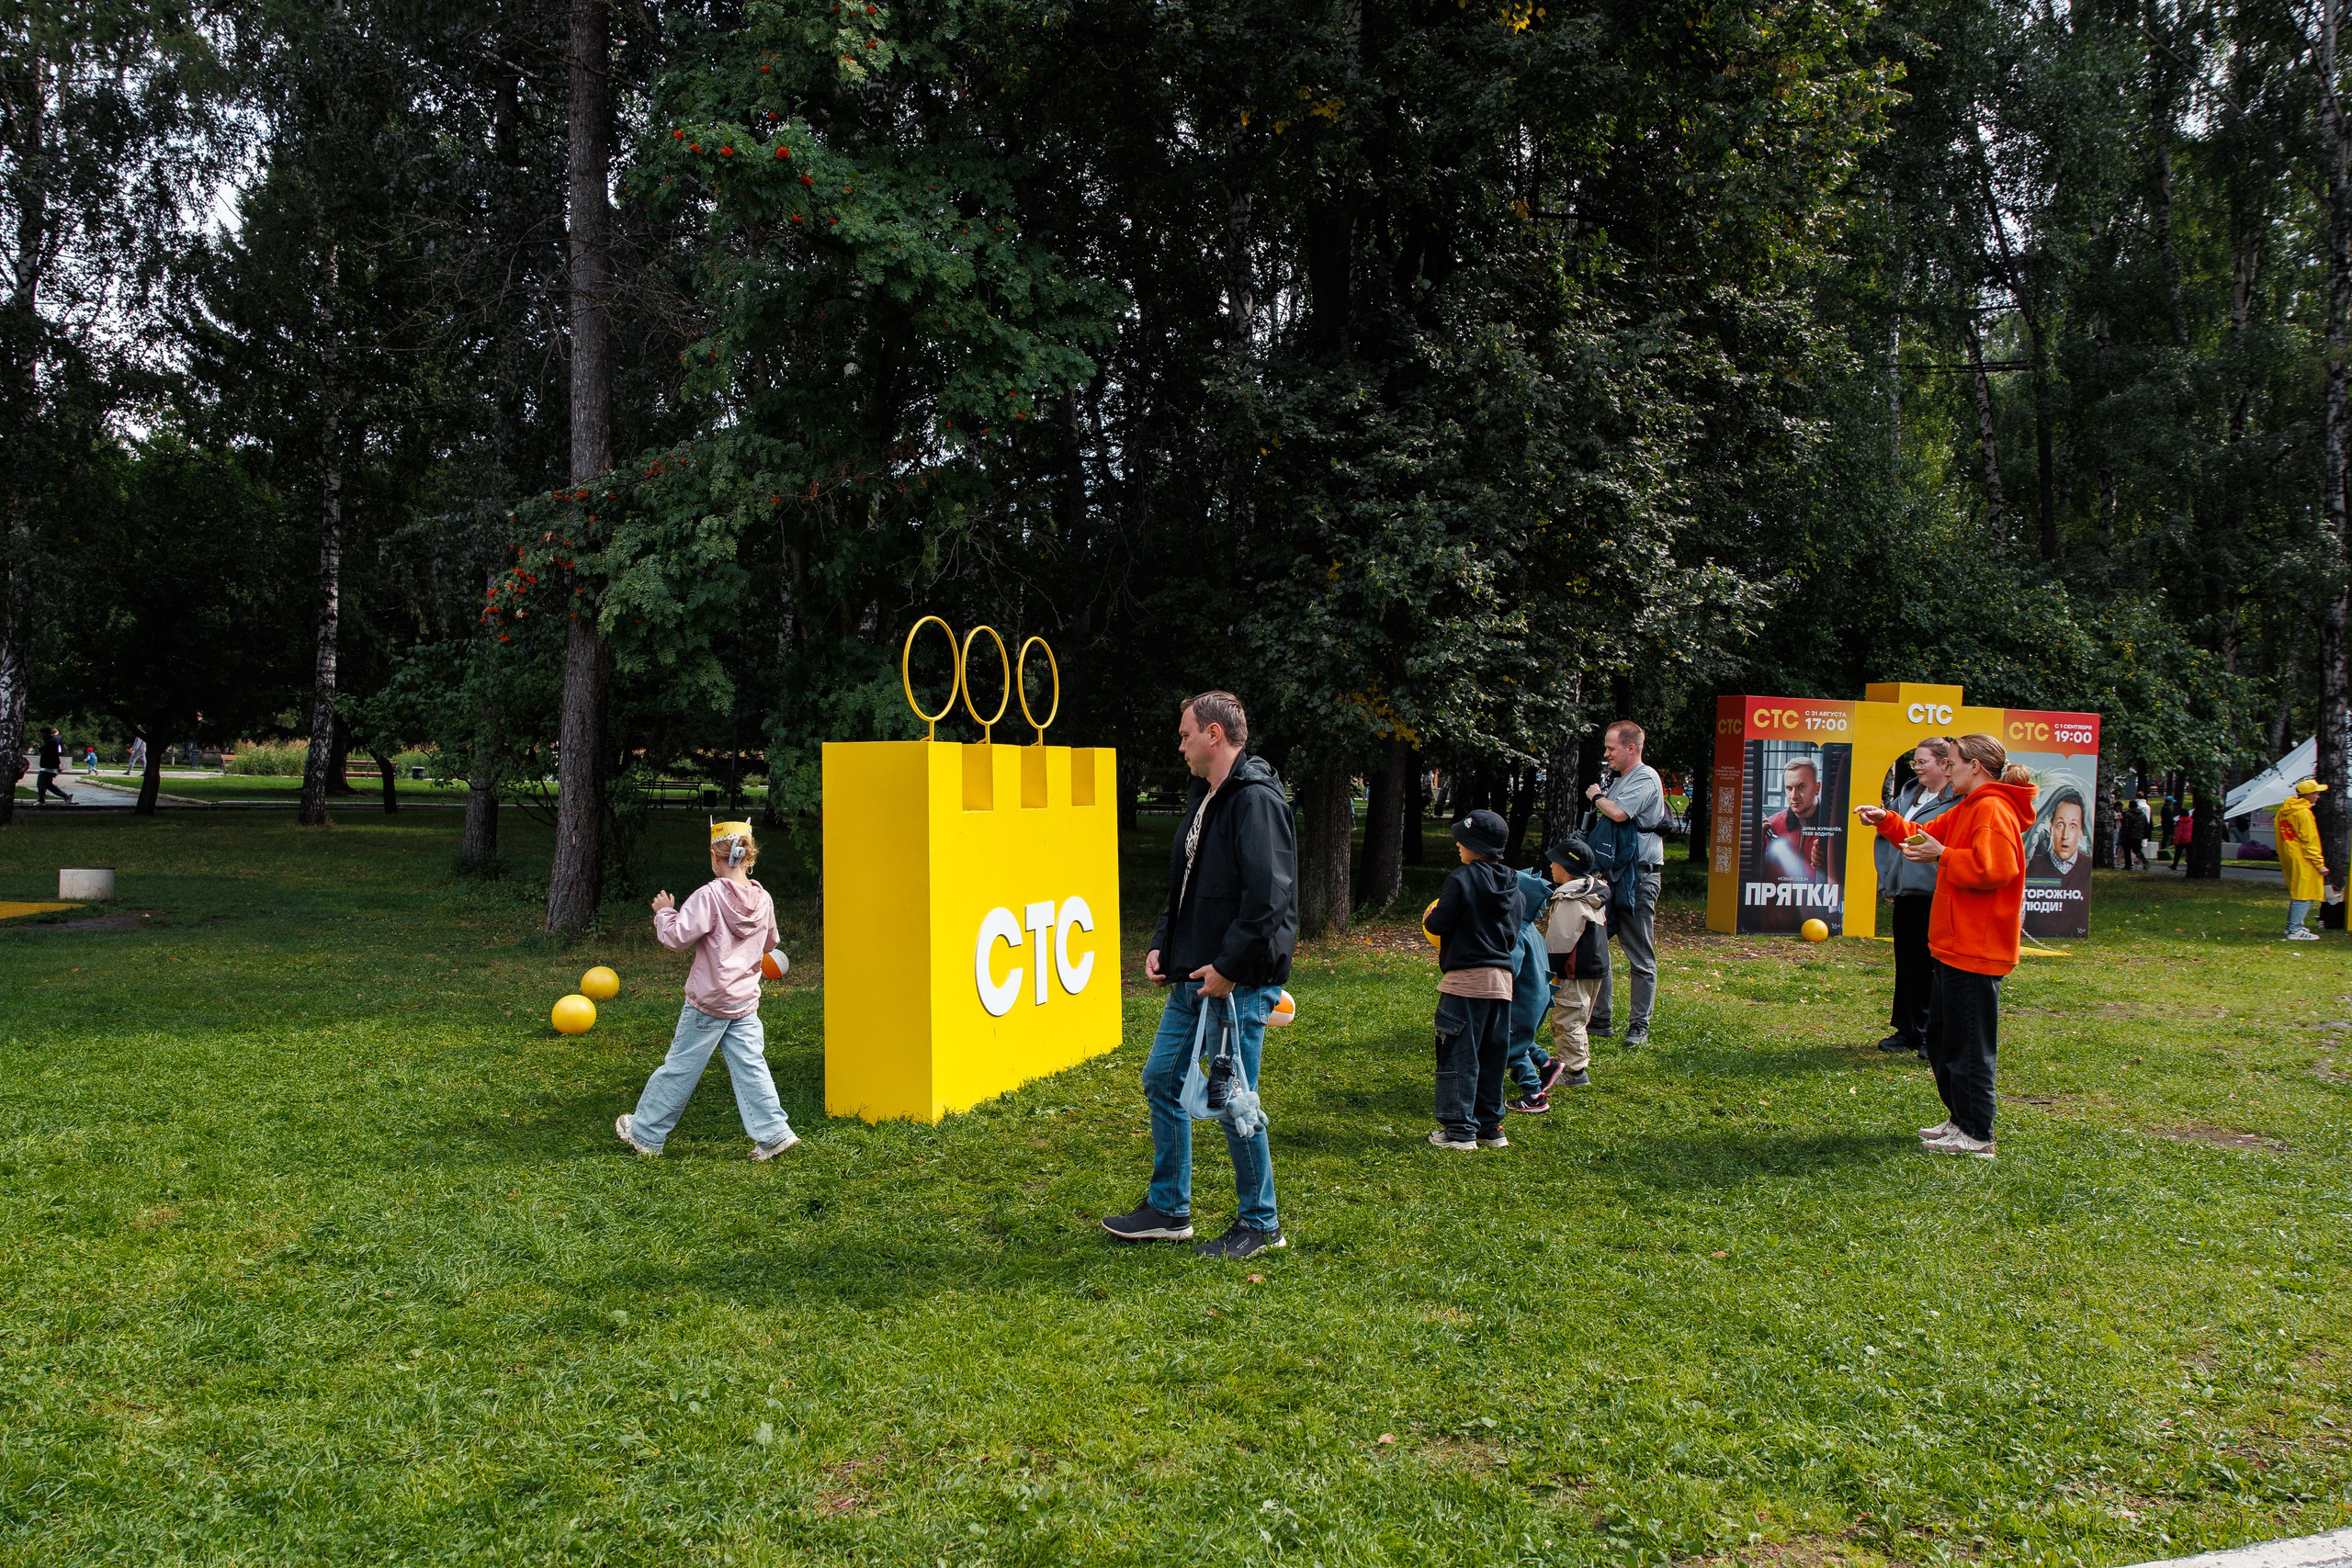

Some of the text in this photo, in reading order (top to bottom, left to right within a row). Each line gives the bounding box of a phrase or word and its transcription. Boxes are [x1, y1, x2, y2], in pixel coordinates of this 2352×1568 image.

[1753, 708, 1799, 728] СТС
[1907, 703, 1953, 725] СТС
[1718, 718, 1743, 735] СТС
[1804, 717, 1848, 731] 17:00
[2008, 721, 2050, 741] СТС
[2054, 730, 2093, 744] 19:00
[1745, 882, 1839, 907] ПРЯТКИ
[2022, 888, 2084, 901] ТОРОЖНО,
[2022, 901, 2064, 914] ЛЮДИ!
[975, 896, 1095, 1017] СТС
